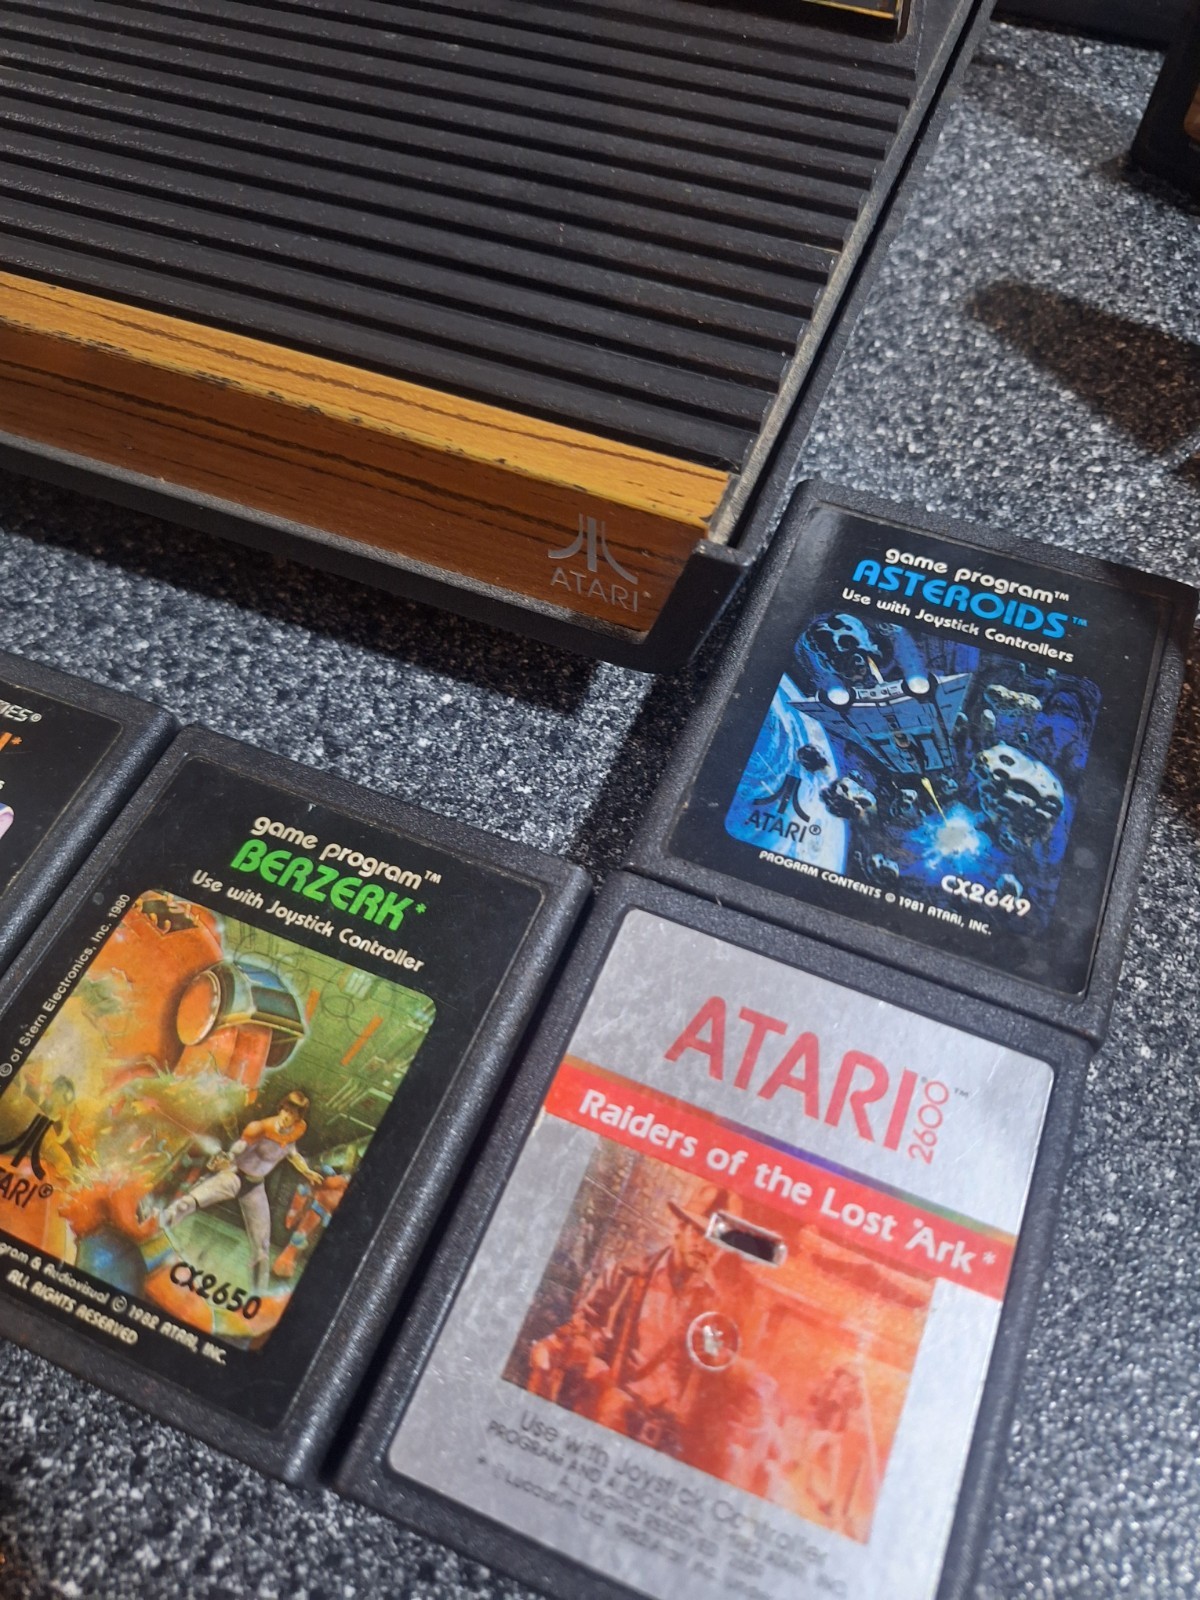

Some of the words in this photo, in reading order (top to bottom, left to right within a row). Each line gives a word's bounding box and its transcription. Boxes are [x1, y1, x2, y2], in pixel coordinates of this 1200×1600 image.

[885, 548, 948, 574] game
[842, 588, 871, 606] Use
[877, 598, 911, 617] with
[915, 608, 980, 636] Joystick
[984, 628, 1074, 663] Controllers
[250, 816, 318, 850] game
[192, 869, 223, 893] Use
[226, 885, 263, 909] with
[266, 900, 335, 938] Joystick
[338, 928, 425, 972] Controller
[759, 850, 819, 878] PROGRAM
[821, 871, 882, 899] CONTENTS
[899, 896, 924, 914] 1981
[927, 906, 965, 927] ATARI,
[969, 920, 992, 936] INC.
[941, 875, 1031, 917] CX2649
[10, 1049, 23, 1063] of
[18, 1015, 48, 1047] Stern
[42, 946, 97, 1013] Electronics,
[90, 923, 113, 943] Inc.
[108, 894, 131, 919] 1980
[663, 996, 919, 1152] ATARI
[908, 1081, 950, 1165] 2600
[578, 1089, 698, 1158] Raiders
[706, 1147, 749, 1176] of
[754, 1163, 813, 1205] the
[820, 1187, 898, 1242] Lost
[7, 1269, 30, 1290] ALL
[30, 1280, 77, 1313] RIGHTS
[75, 1303, 139, 1345] RESERVED
[30, 1256, 42, 1272] &
[43, 1263, 110, 1304] Audiovisual
[128, 1304, 160, 1330] 1982
[160, 1321, 199, 1353] ATARI,
[201, 1342, 227, 1366] INC.
[170, 1261, 262, 1320] CX2650
[520, 1411, 558, 1443] Use
